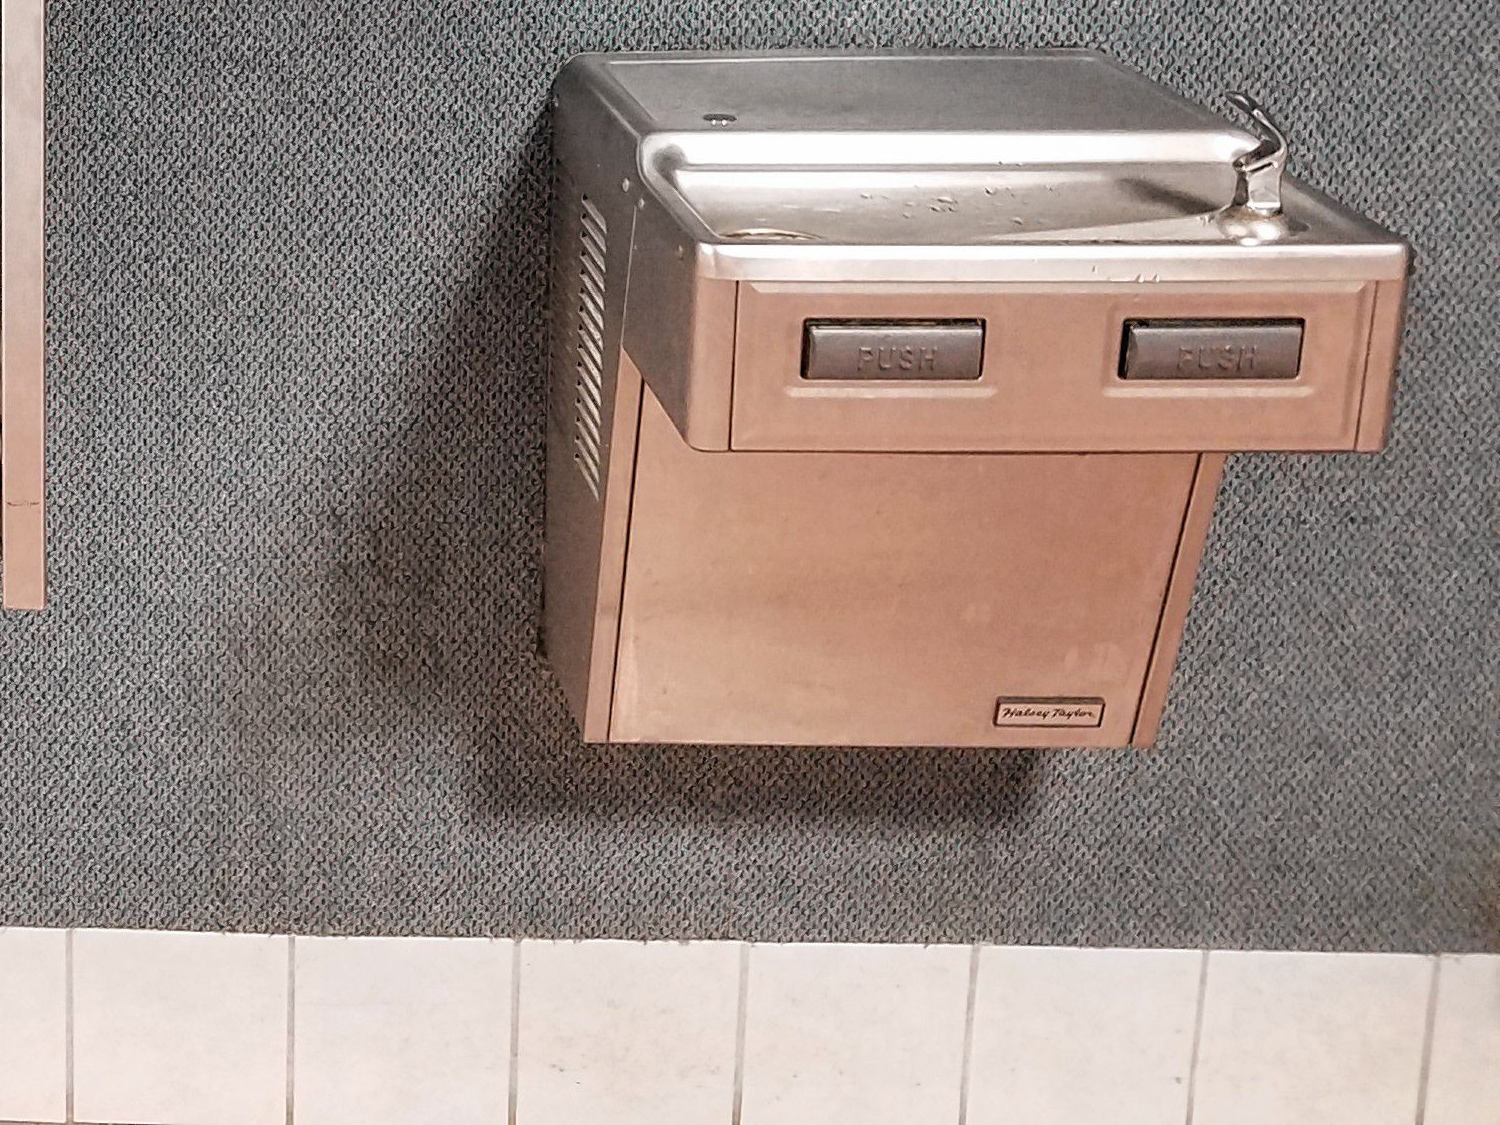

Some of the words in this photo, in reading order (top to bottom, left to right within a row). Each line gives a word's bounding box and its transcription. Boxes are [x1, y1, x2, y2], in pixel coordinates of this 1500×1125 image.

[857, 346, 938, 372] PUSH
[1178, 345, 1257, 372] PUSH
[1002, 708, 1050, 720] Halsey
[1051, 708, 1096, 720] Taylor
